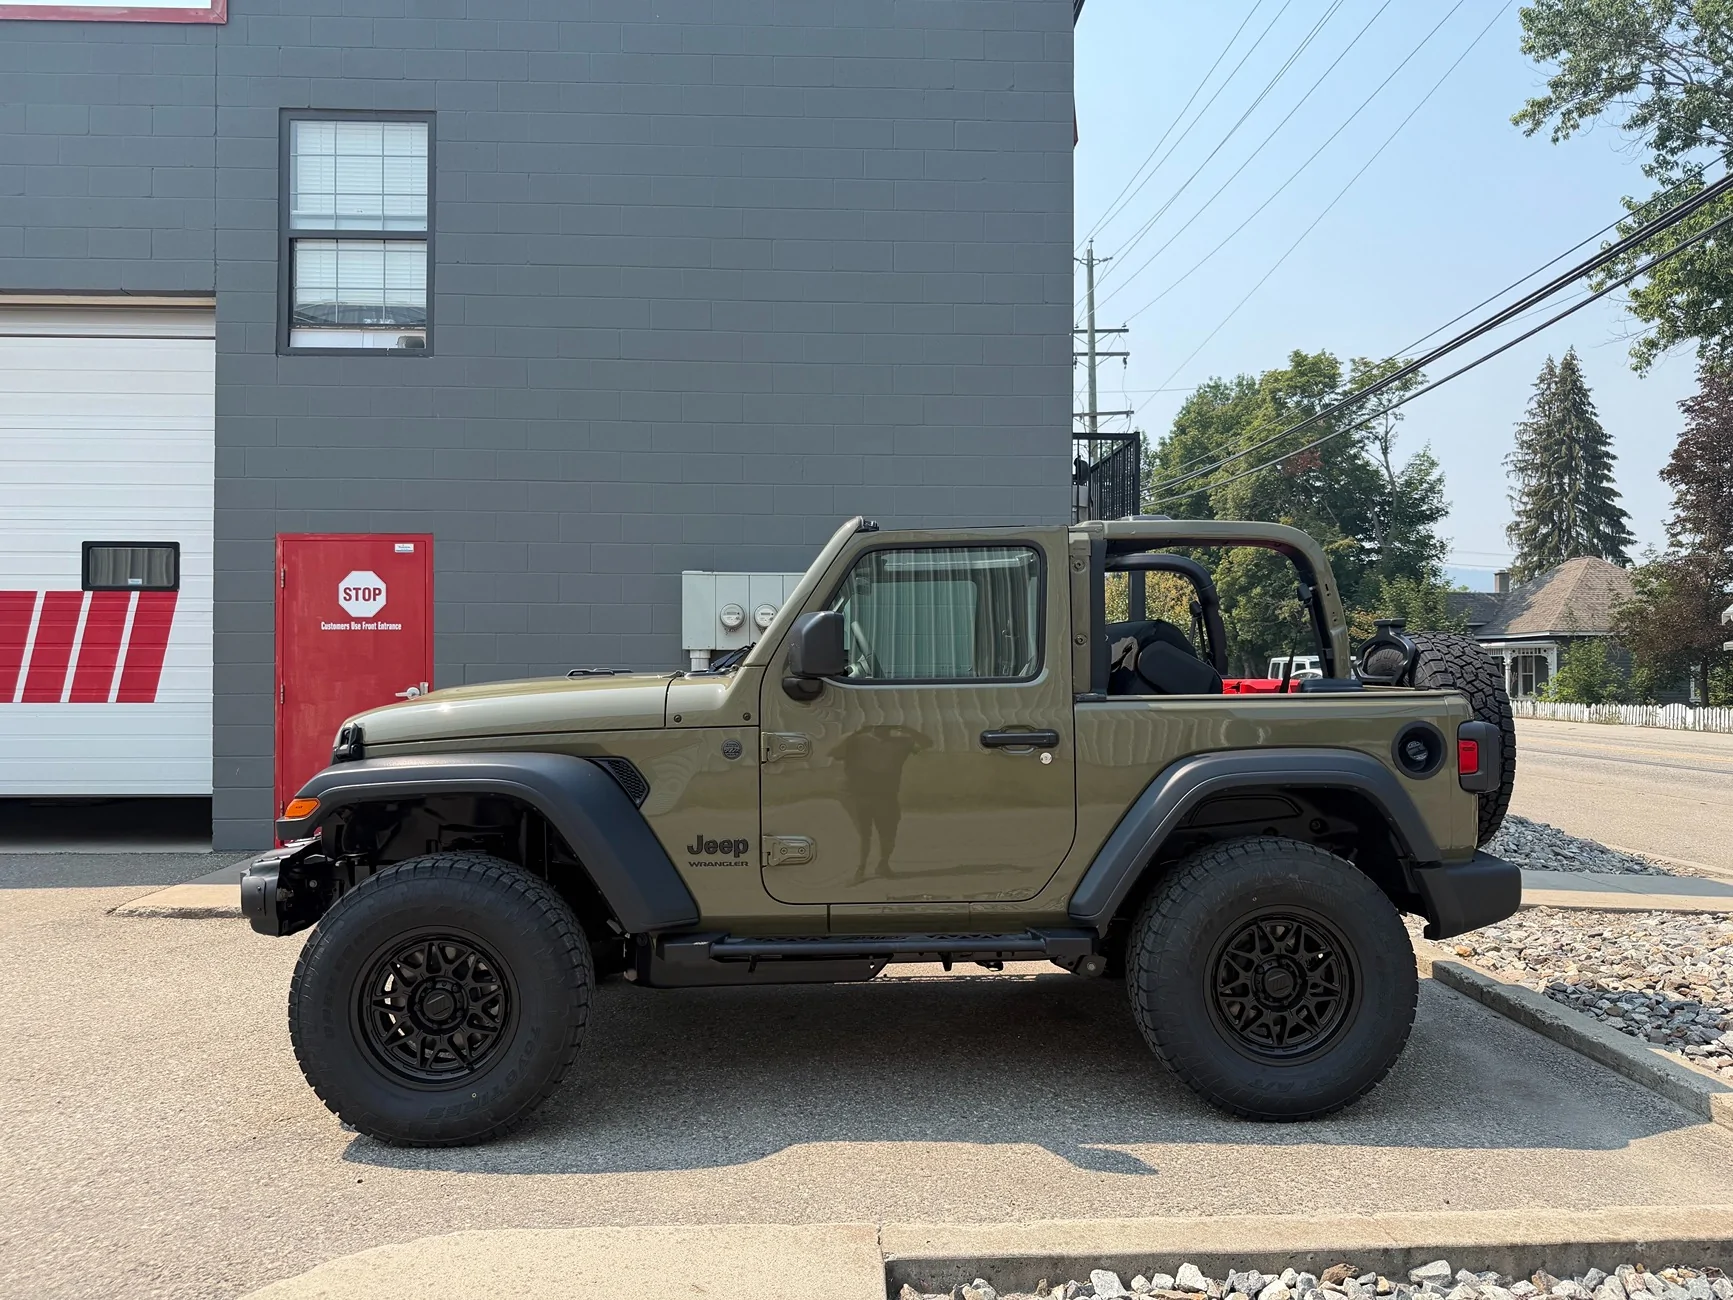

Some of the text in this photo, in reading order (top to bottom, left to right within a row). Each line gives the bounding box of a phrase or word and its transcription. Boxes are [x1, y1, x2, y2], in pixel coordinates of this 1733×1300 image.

[343, 587, 382, 602] STOP
[321, 621, 402, 630] Customers Use Front Entrance
[687, 834, 749, 858] Jeep
